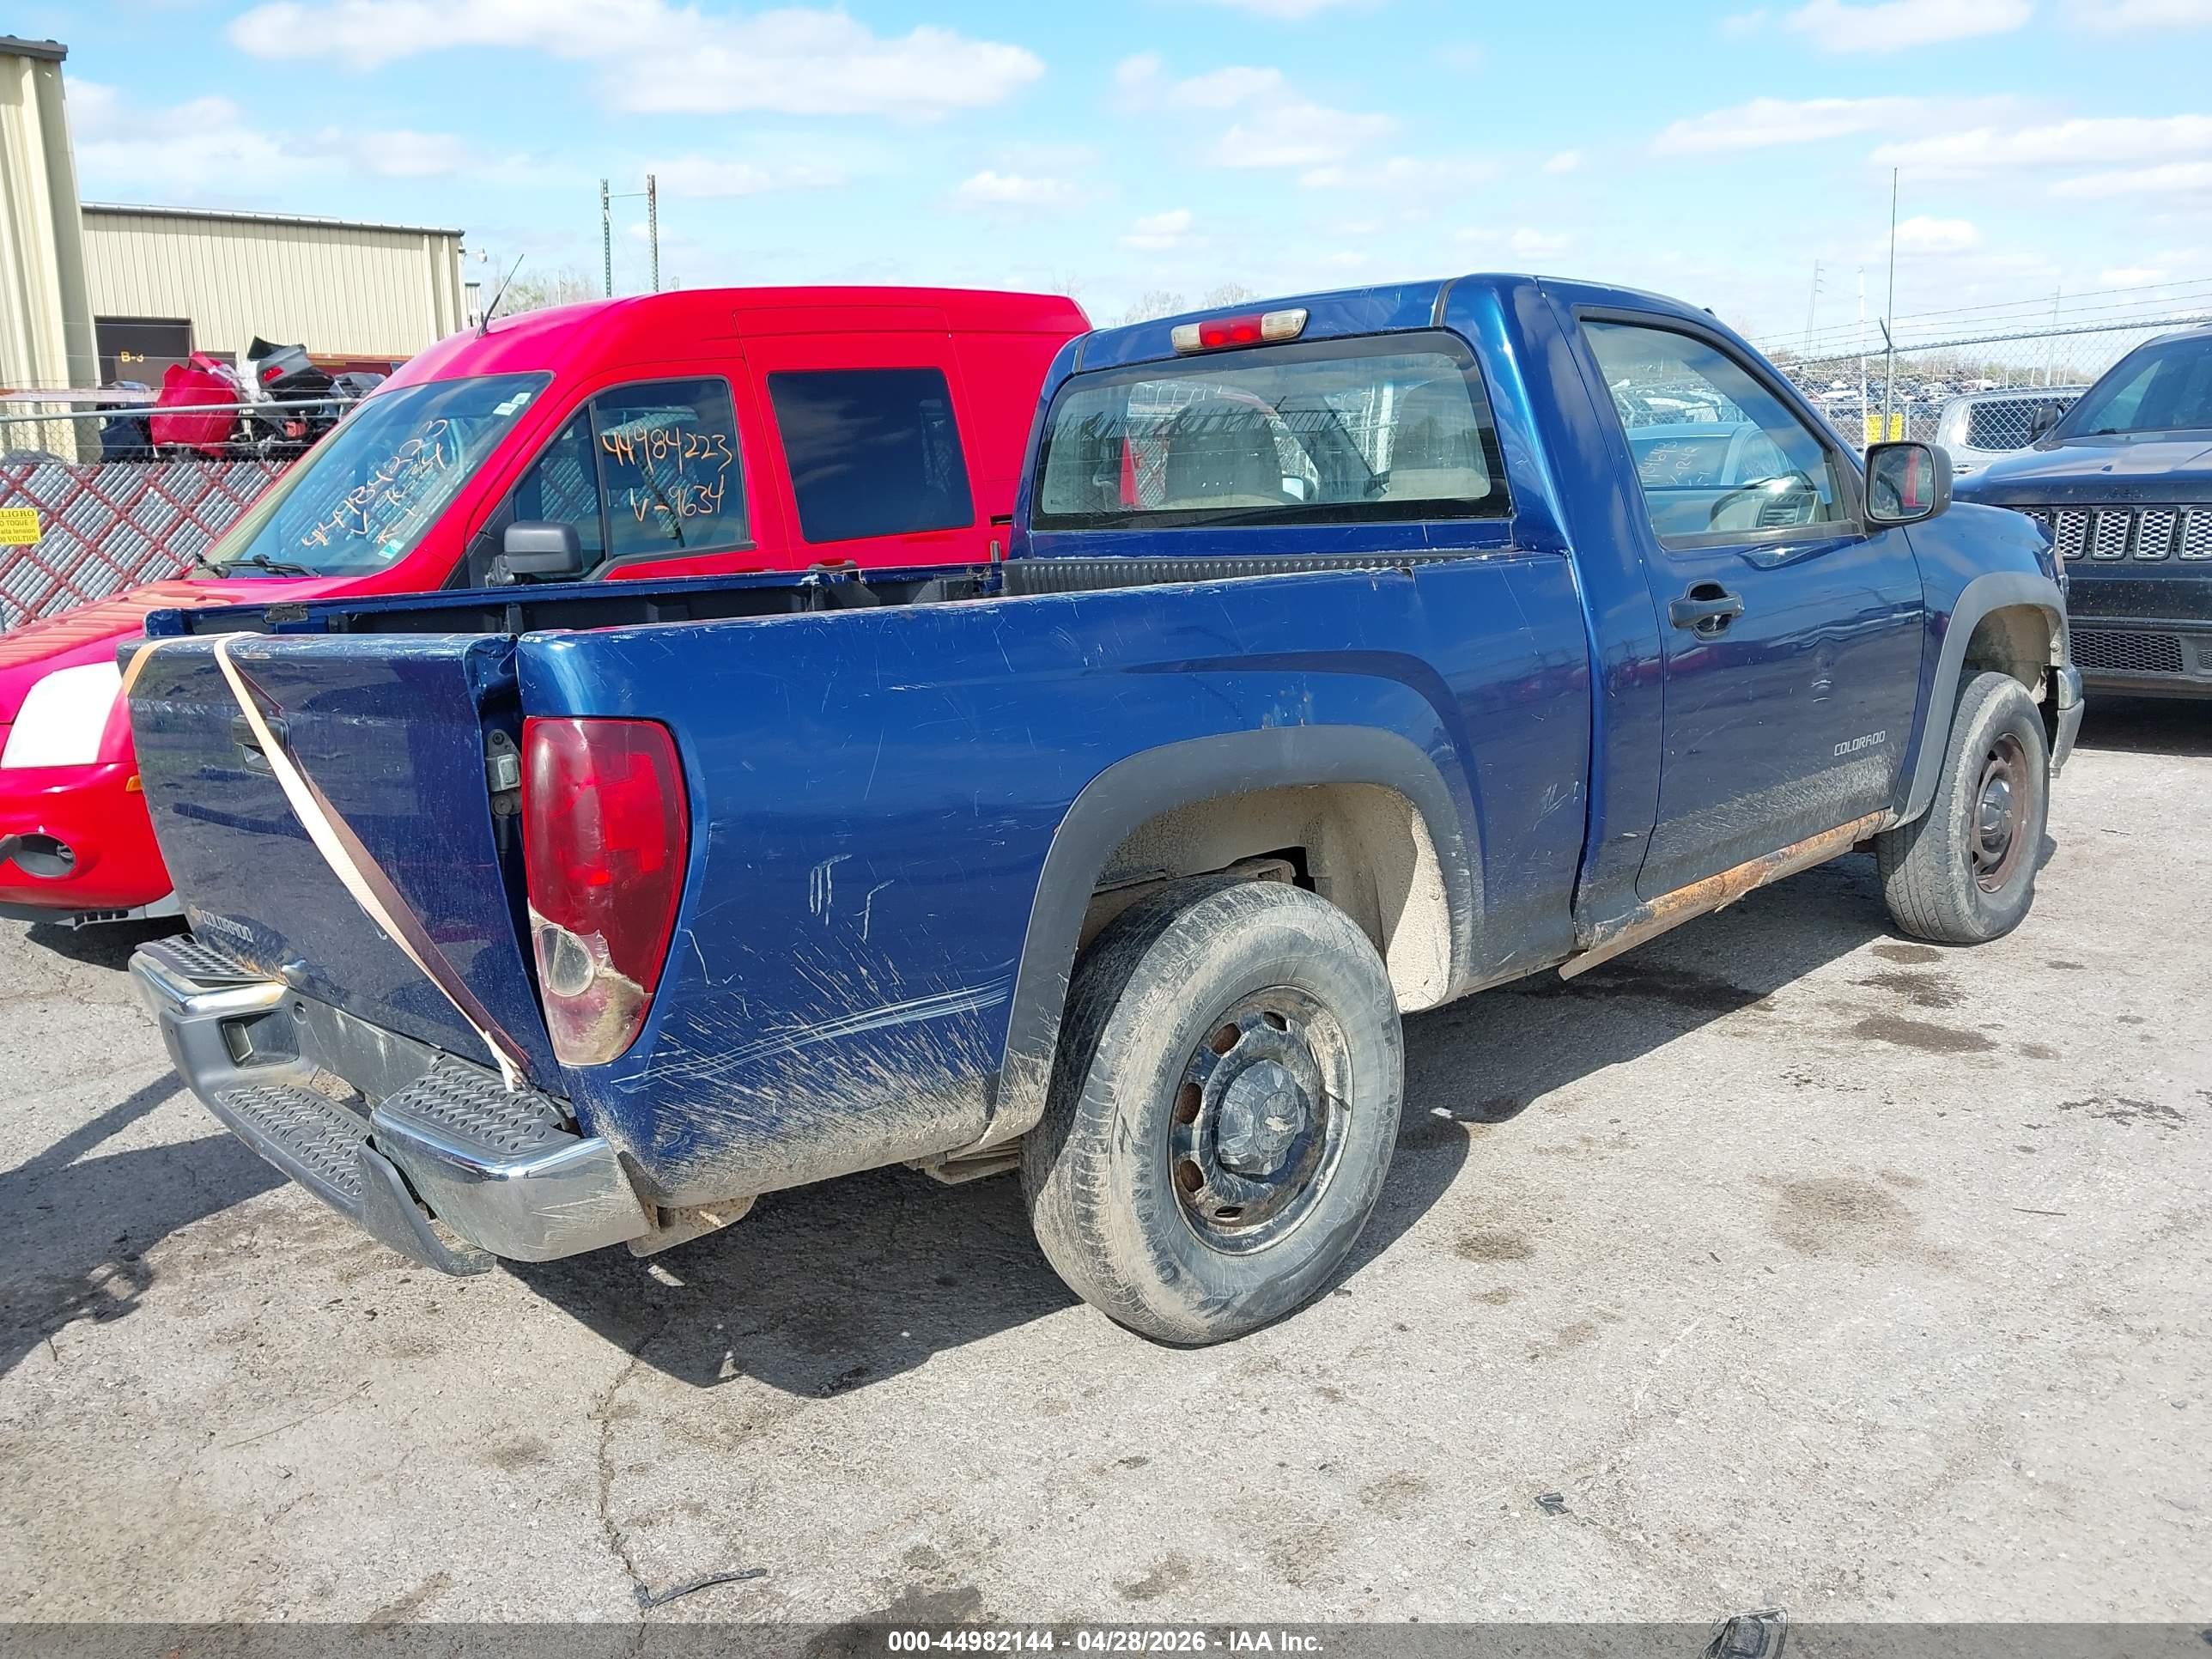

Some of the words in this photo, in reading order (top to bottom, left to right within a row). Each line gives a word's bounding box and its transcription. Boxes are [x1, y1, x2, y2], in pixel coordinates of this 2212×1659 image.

[602, 426, 732, 475] 44984223
[1834, 730, 1887, 757] COLORADO
[201, 909, 255, 943] COLORADO
